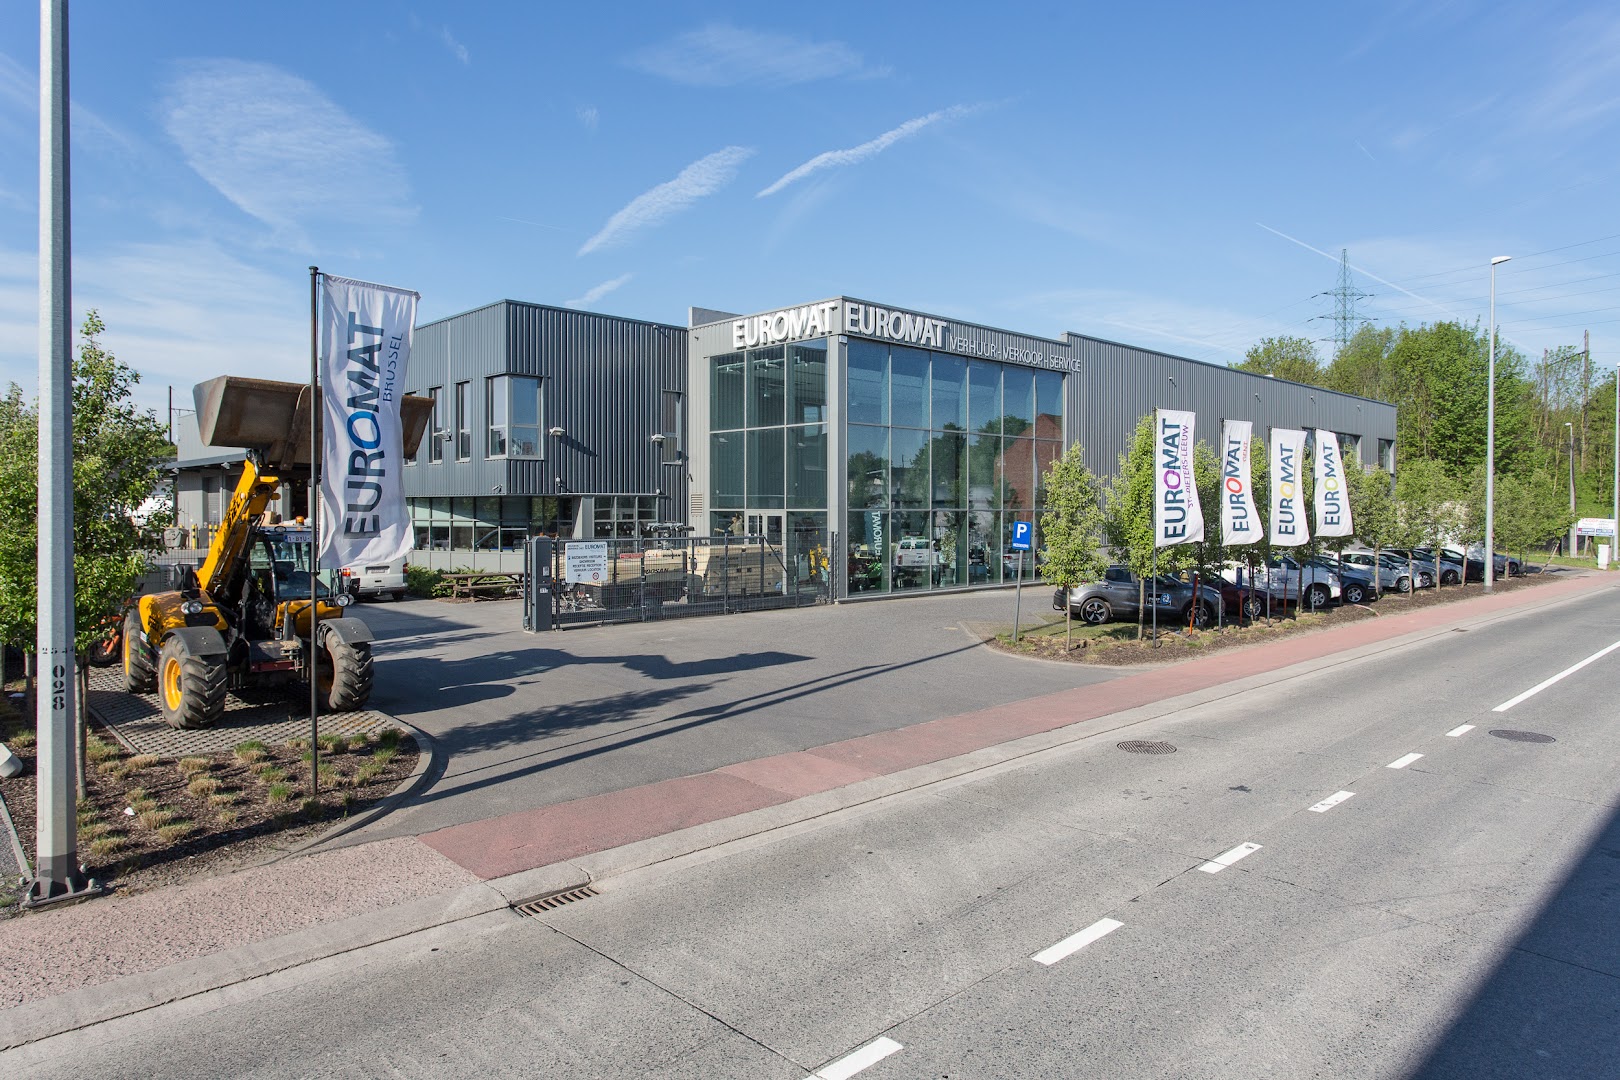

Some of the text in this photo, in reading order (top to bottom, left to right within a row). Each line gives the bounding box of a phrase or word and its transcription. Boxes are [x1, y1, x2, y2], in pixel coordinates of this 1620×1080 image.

[732, 302, 836, 349] EUROMAT
[845, 302, 946, 347] EUROMAT
[950, 335, 1081, 372] VERHUUR VERKOOP SERVICE
[382, 332, 404, 402] BRUSSEL
[343, 311, 385, 539] EUROMAT
[1162, 418, 1187, 539] EUROMAT
[1225, 435, 1250, 531] EUROMAT
[1278, 443, 1295, 535] EUROMAT
[1323, 442, 1341, 525] EUROMAT
[1016, 523, 1028, 539] P
[53, 665, 65, 711] 028
